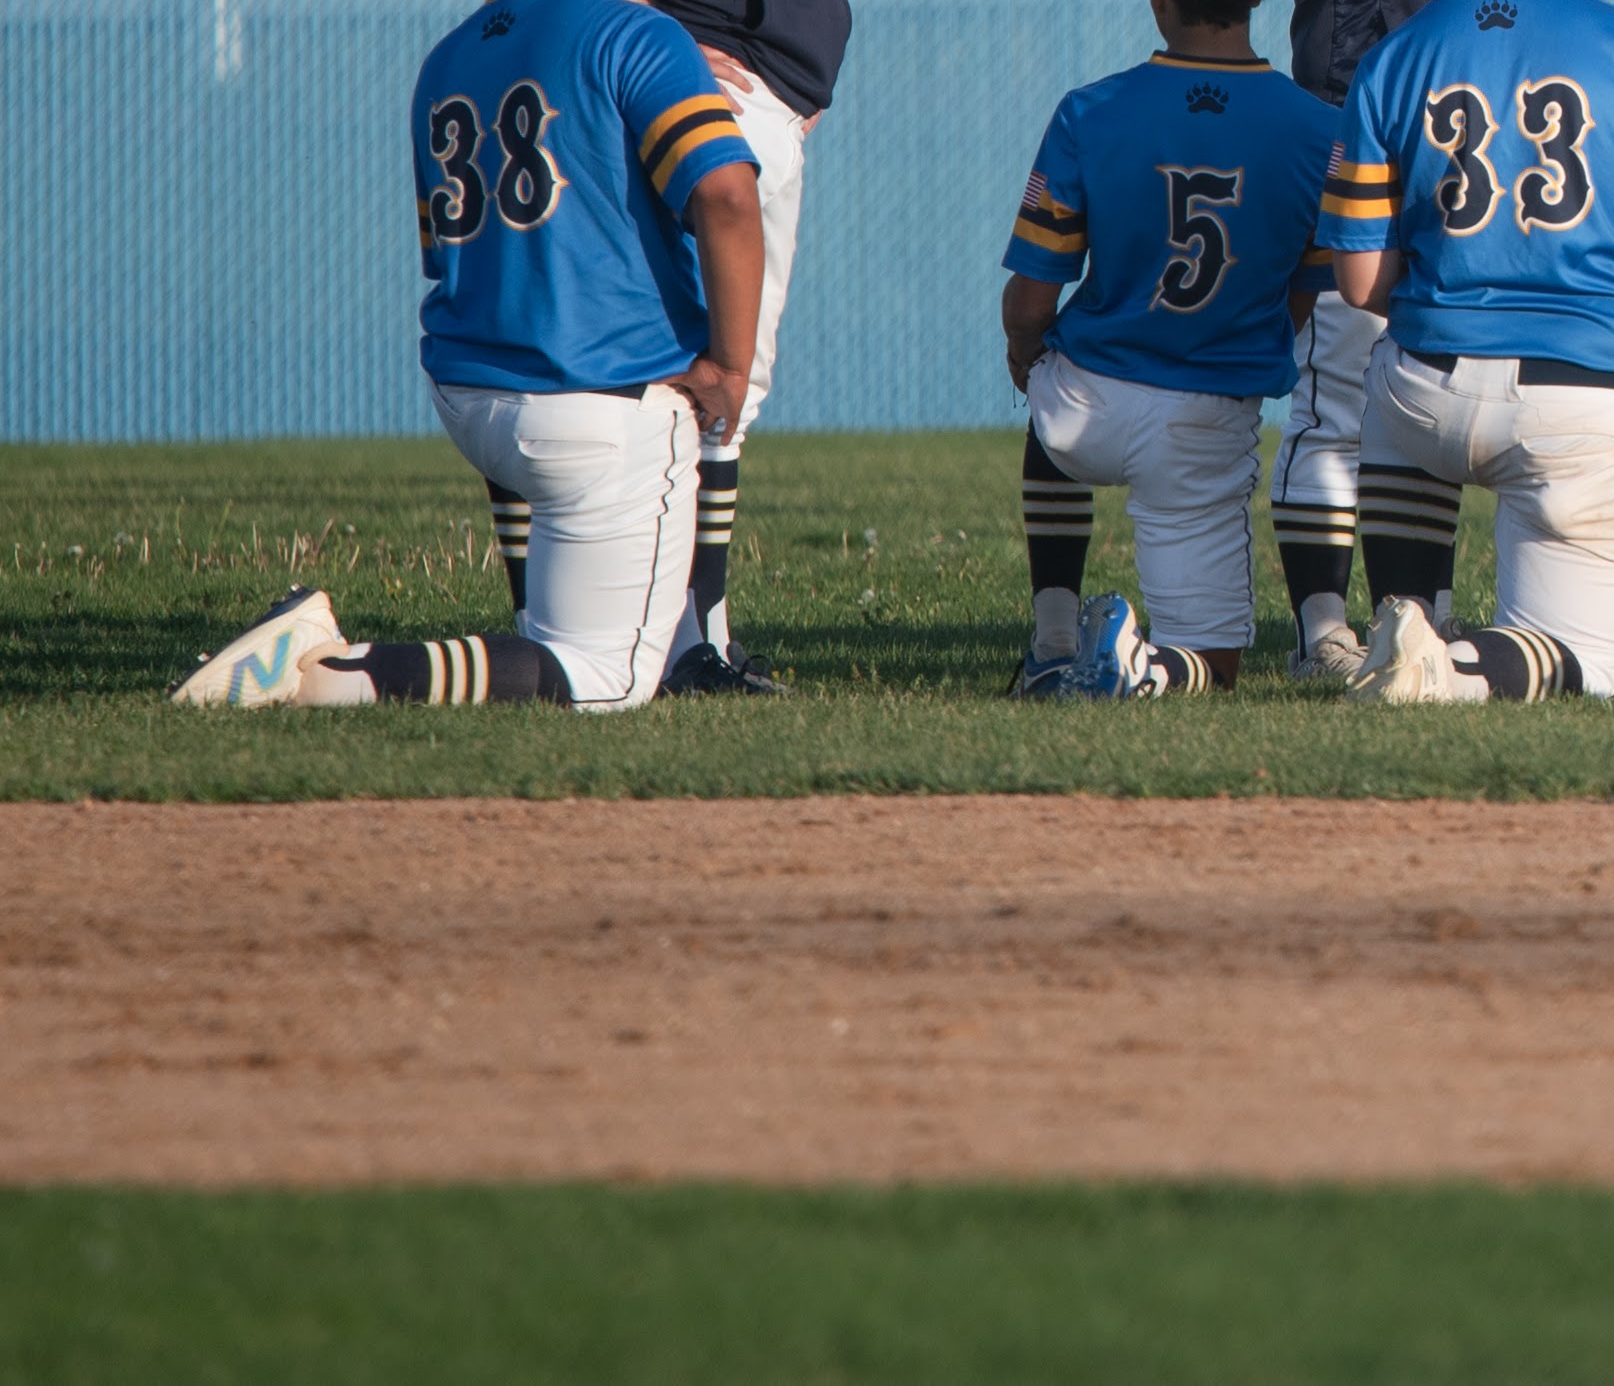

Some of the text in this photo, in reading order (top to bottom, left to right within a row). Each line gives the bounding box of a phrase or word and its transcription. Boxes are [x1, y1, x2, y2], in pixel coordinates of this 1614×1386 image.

[429, 78, 569, 251] 38
[1425, 76, 1595, 237] 33
[1150, 165, 1244, 313] 5
